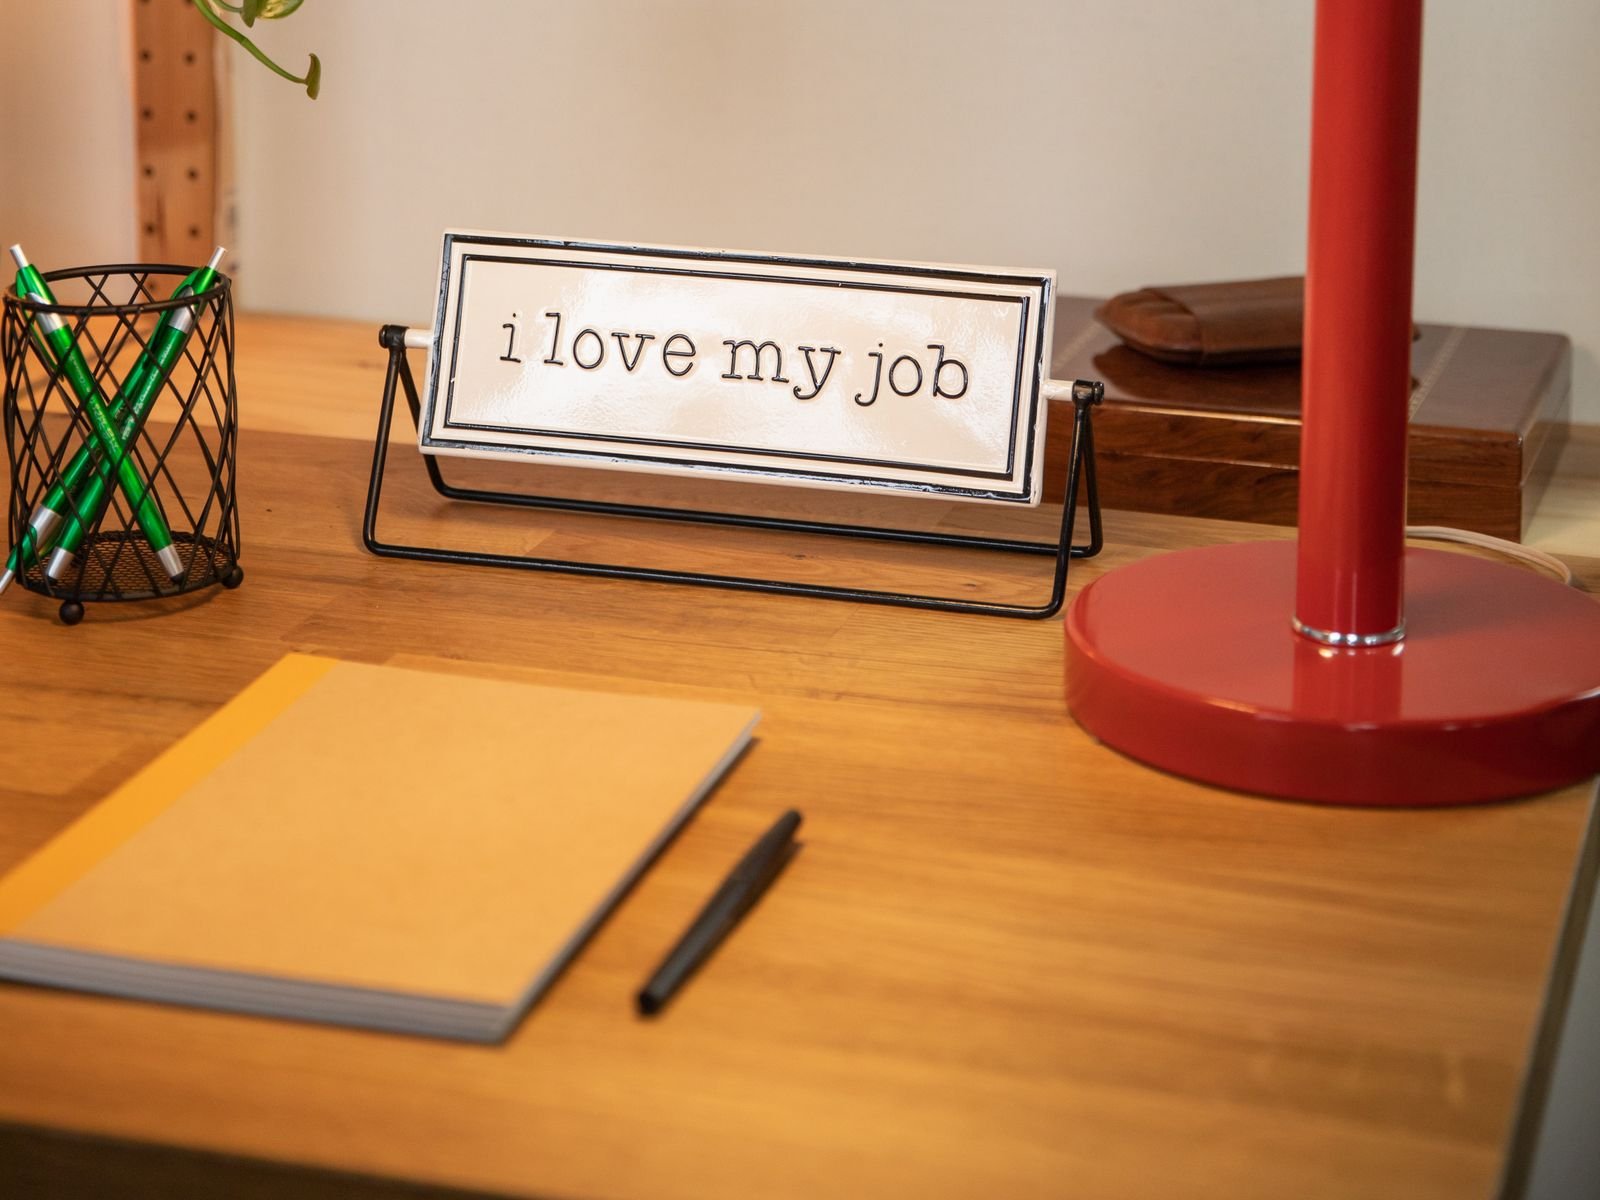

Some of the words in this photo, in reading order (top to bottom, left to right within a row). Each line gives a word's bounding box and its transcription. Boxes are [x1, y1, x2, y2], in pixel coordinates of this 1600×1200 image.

[499, 312, 522, 364] i
[543, 312, 697, 377] love
[721, 339, 842, 401] my
[854, 342, 969, 407] job
